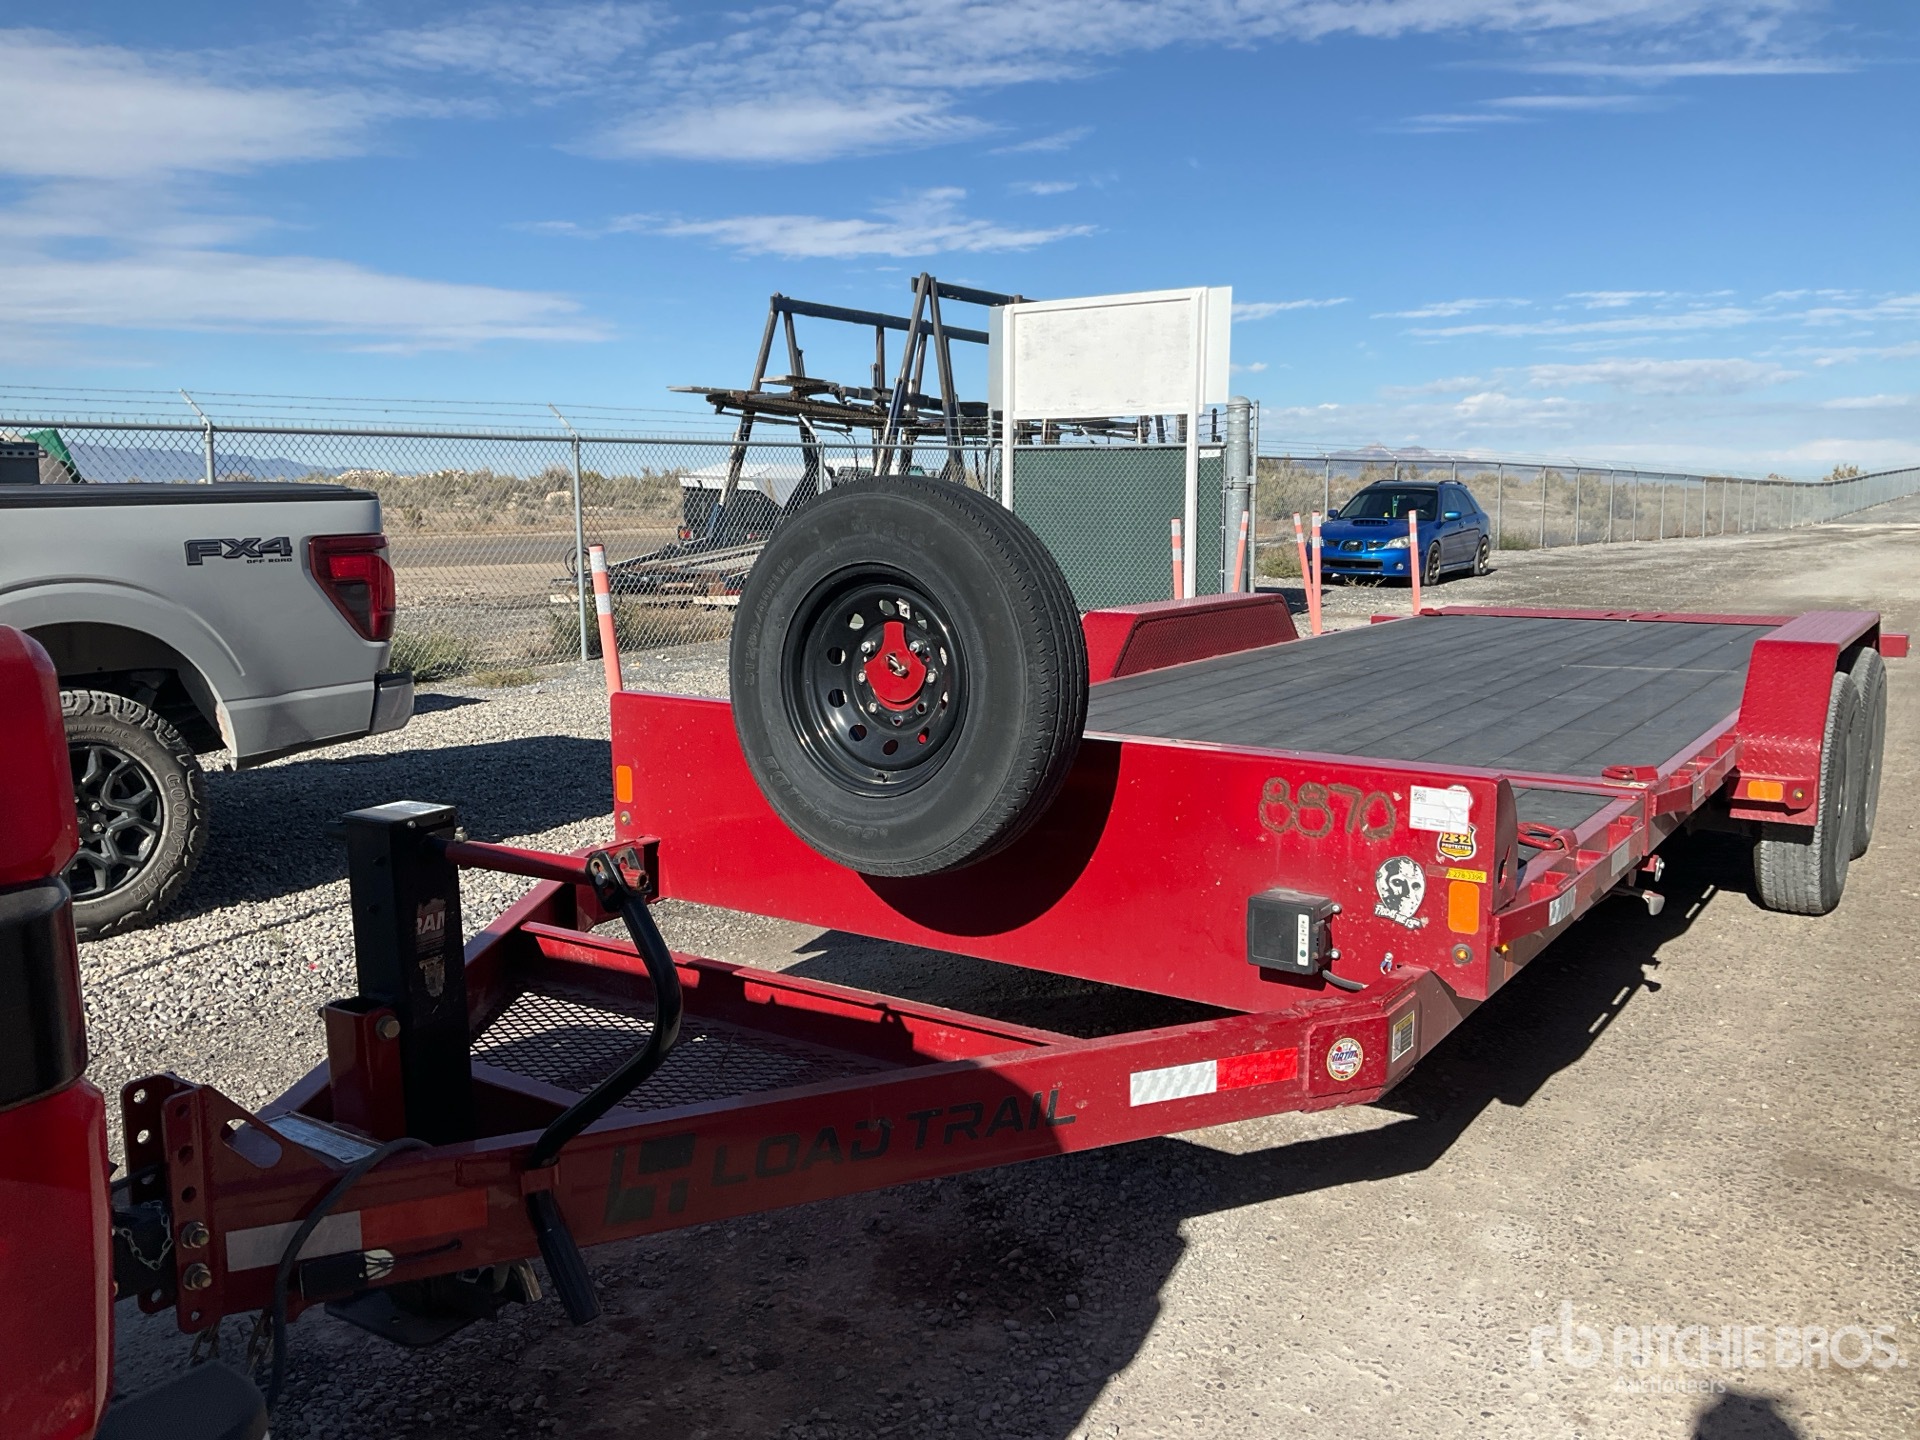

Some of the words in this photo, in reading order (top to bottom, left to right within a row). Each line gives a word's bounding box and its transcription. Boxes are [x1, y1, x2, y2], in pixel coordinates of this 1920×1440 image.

[184, 536, 292, 566] FX4
[131, 774, 189, 902] GOODYEAR
[1258, 776, 1397, 839] 8870
[1445, 832, 1469, 844] 232
[711, 1118, 892, 1187] LOAD
[906, 1090, 1077, 1151] TRAIL
